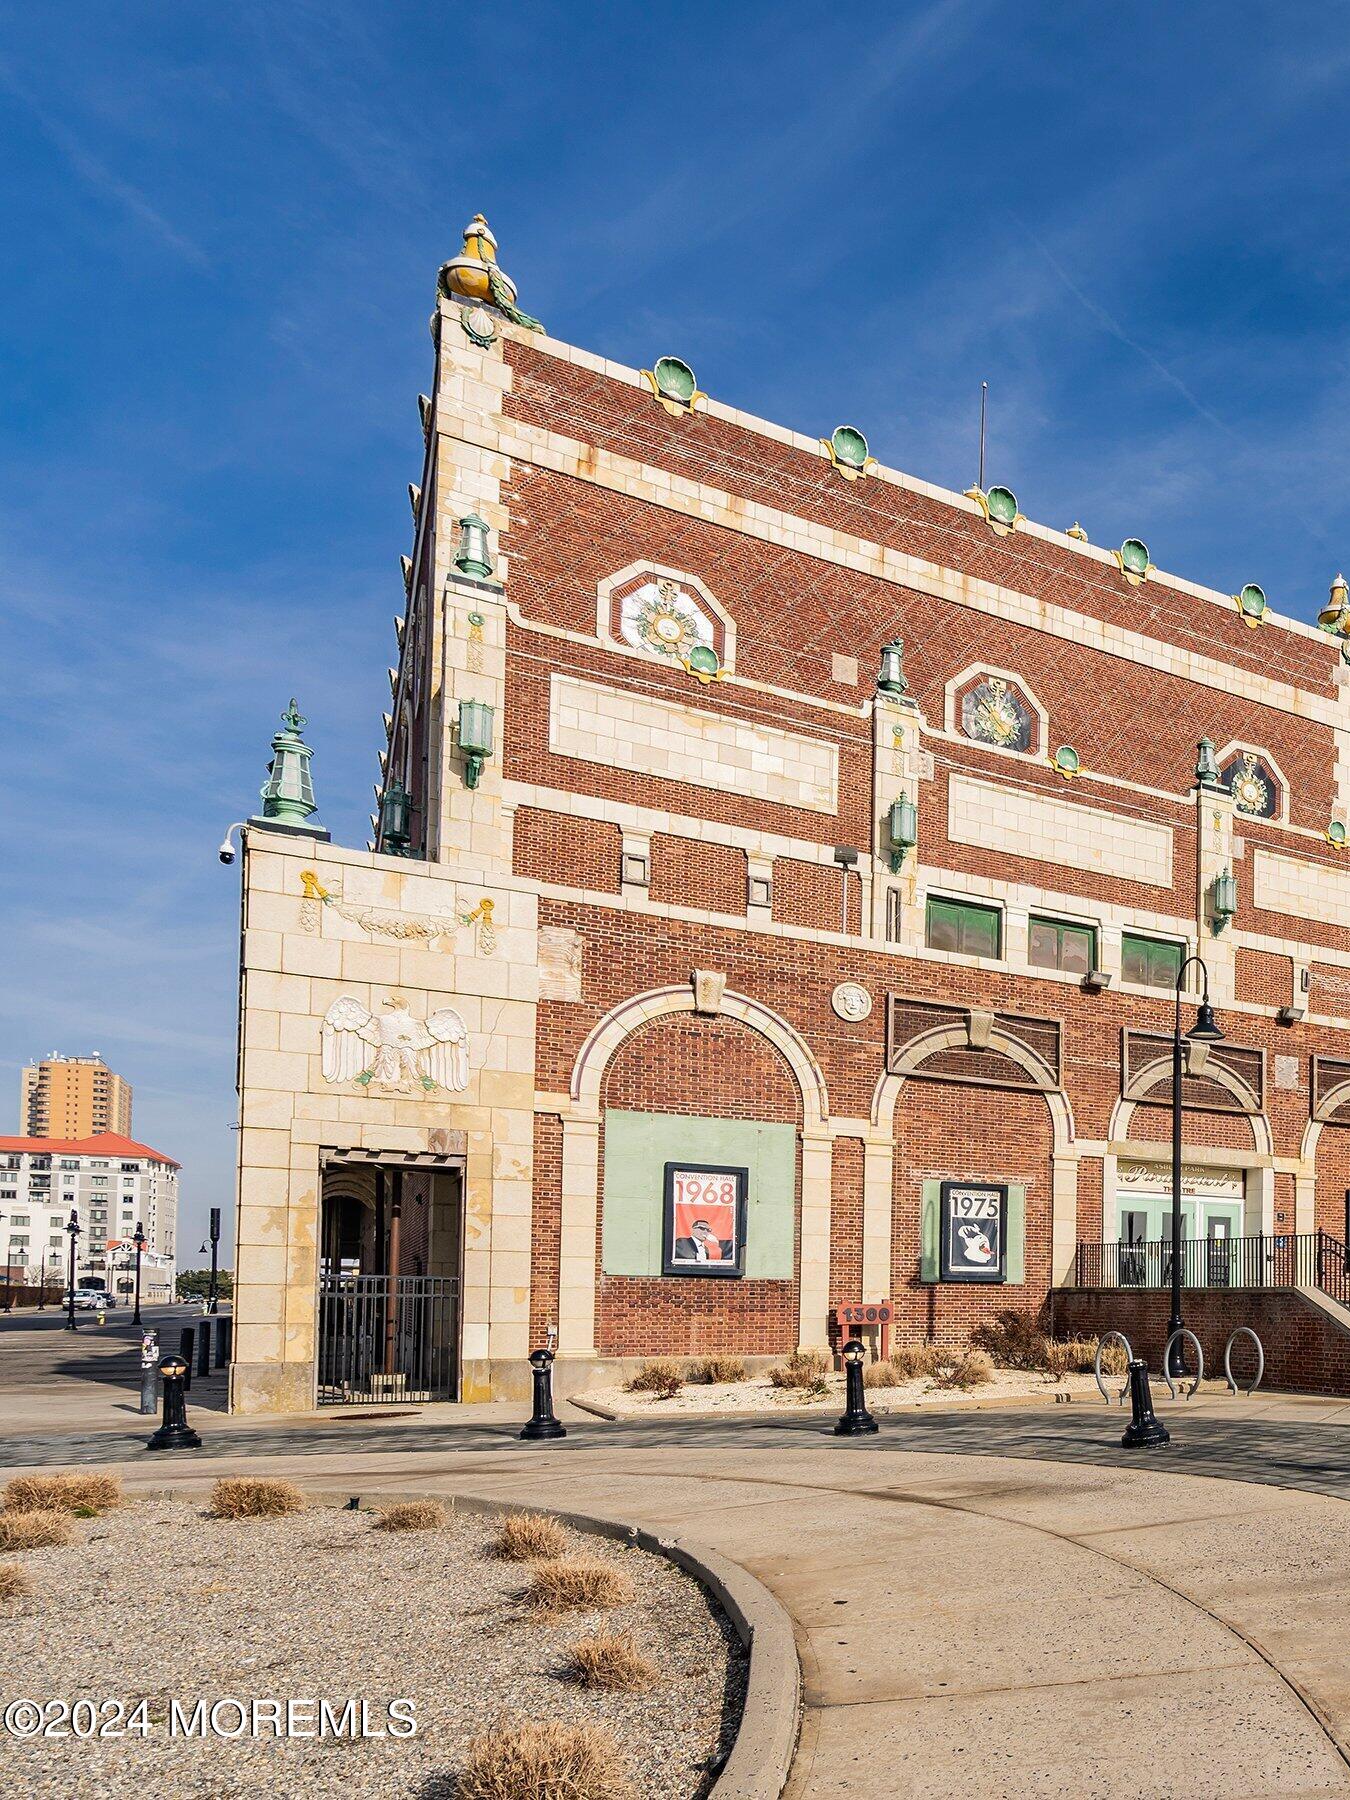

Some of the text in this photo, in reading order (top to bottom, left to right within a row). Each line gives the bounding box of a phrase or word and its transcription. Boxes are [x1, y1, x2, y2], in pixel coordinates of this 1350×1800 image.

[675, 1173, 718, 1181] CONVENTION
[675, 1180, 734, 1205] 1968
[1163, 1185, 1196, 1195] THTRE
[951, 1196, 999, 1217] 1975
[842, 1307, 890, 1322] 1300
